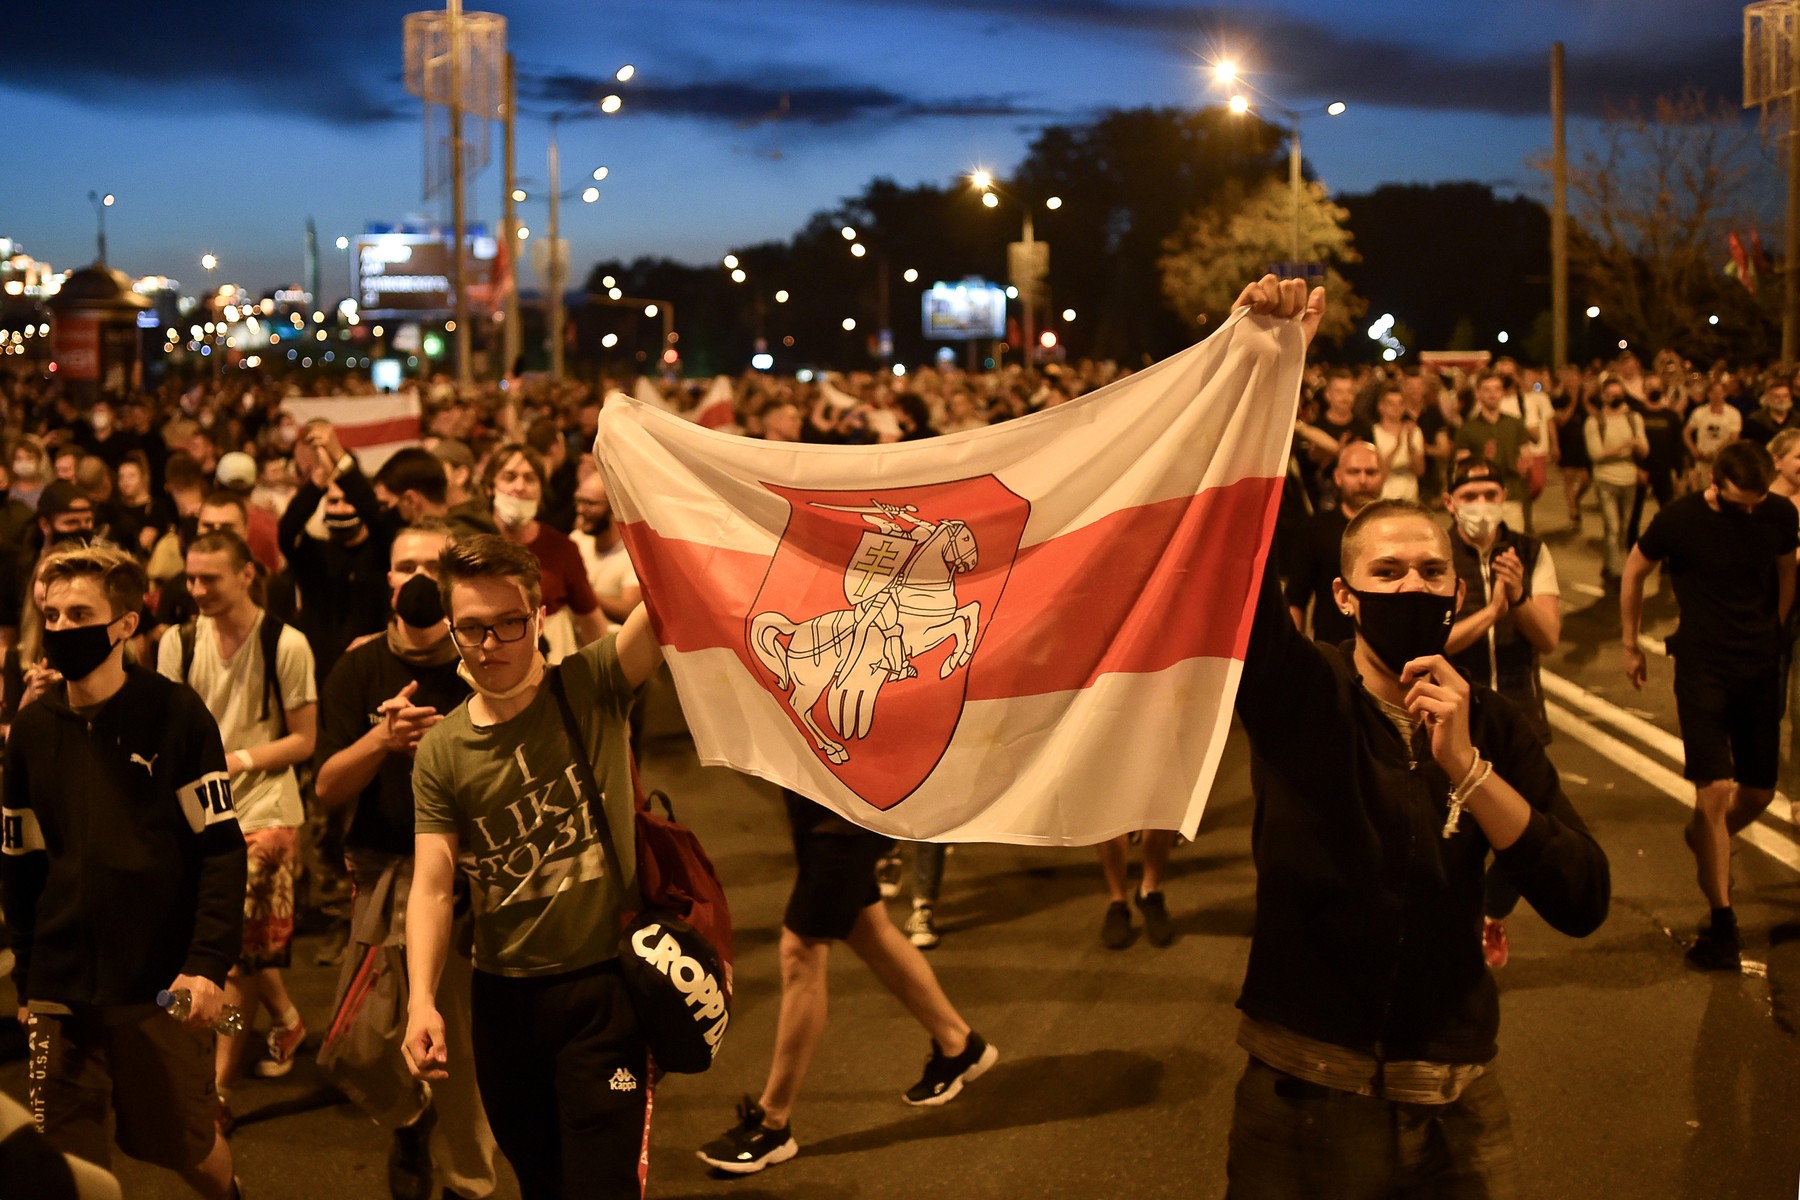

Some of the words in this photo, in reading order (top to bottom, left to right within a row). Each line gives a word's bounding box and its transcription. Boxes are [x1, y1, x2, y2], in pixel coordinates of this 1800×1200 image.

[514, 742, 538, 787] I
[36, 1034, 51, 1080] U.S.A.
[610, 1081, 637, 1092] Kappa
